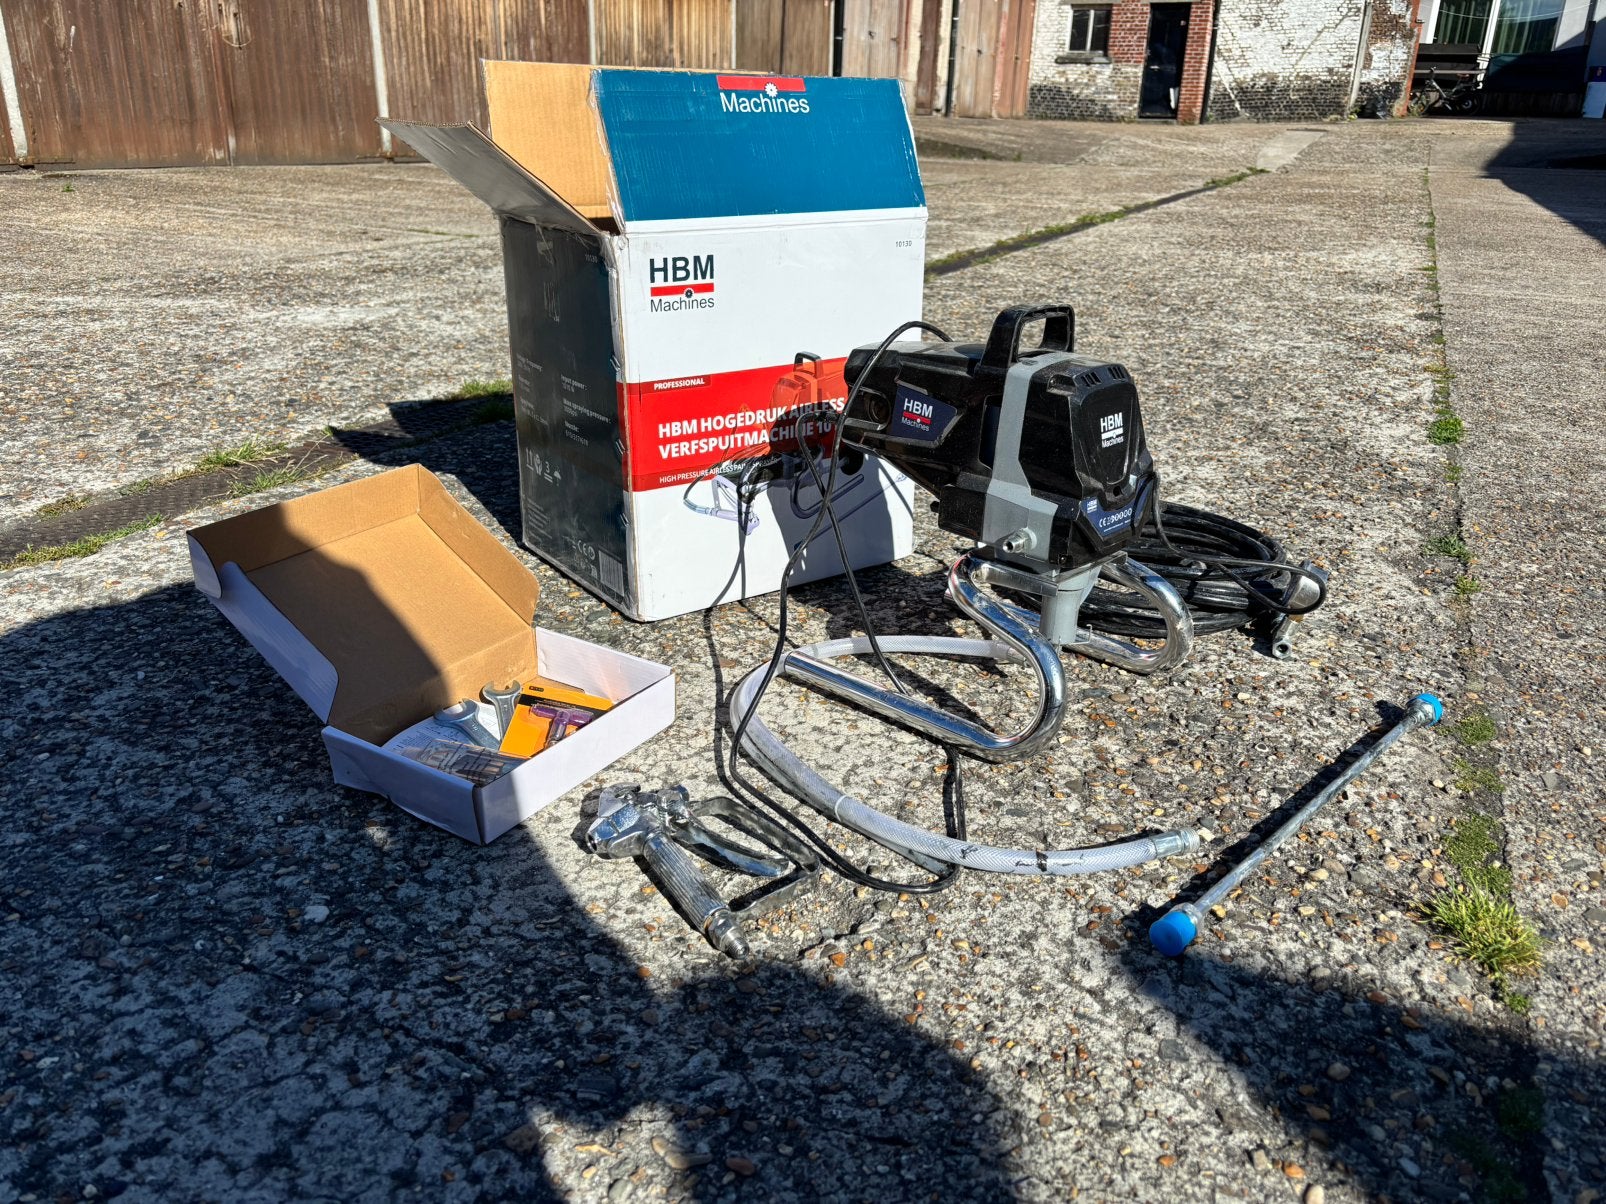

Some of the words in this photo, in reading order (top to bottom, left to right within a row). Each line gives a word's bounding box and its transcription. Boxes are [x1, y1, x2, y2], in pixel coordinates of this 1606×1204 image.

[720, 92, 810, 114] Machines
[895, 240, 912, 248] 10130
[649, 254, 715, 284] HBM
[650, 296, 715, 313] Machines
[654, 377, 705, 390] PROFESSIONAL
[903, 397, 933, 418] HBM
[658, 418, 697, 438] HBM
[701, 405, 788, 431] HOGEDRUK
[901, 415, 930, 432] Machines
[1100, 411, 1124, 433] HBM
[1101, 435, 1124, 449] Machines
[659, 473, 677, 484] HIGH
[677, 469, 708, 481] PRESSURE
[708, 465, 734, 476] AIRLESS
